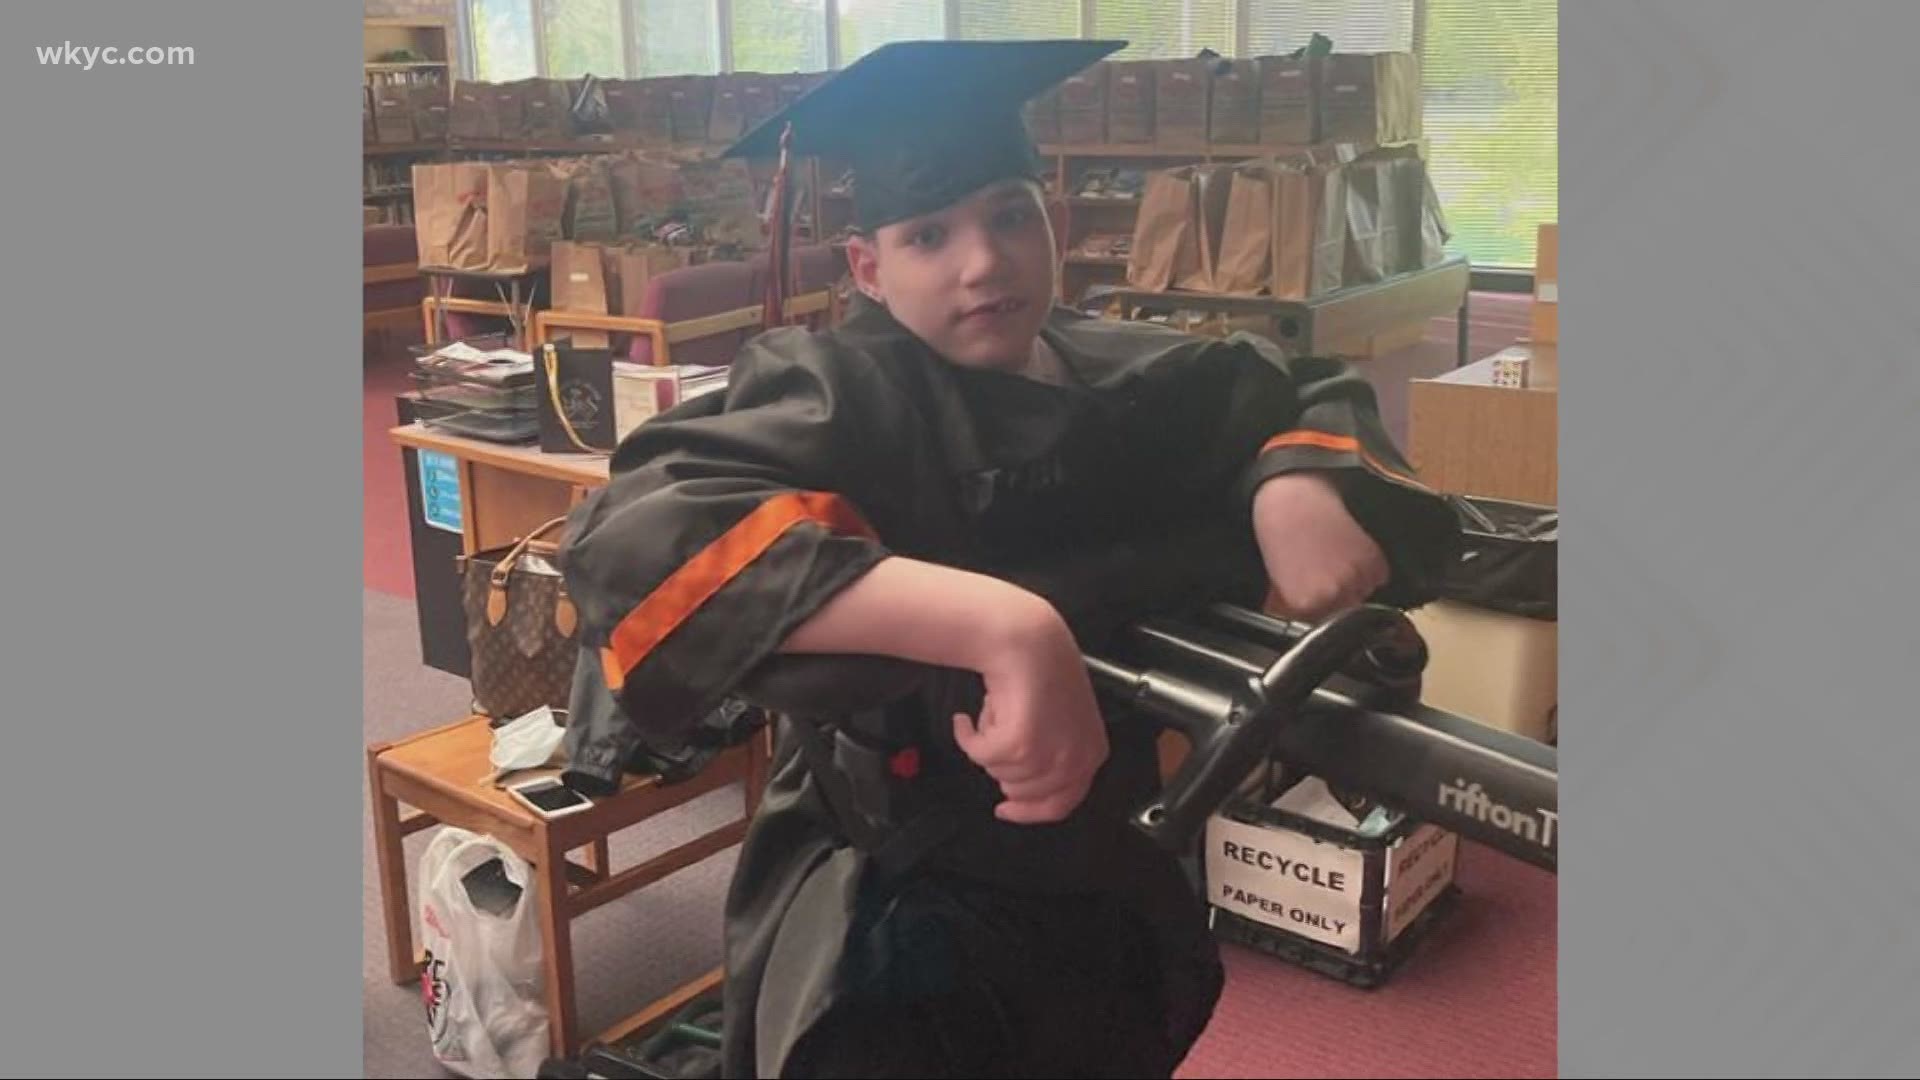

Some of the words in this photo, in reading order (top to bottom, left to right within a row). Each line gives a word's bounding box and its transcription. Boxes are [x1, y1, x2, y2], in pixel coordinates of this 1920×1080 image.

[1223, 841, 1345, 892] RECYCLE
[1223, 885, 1284, 917] PAPER
[1289, 908, 1346, 935] ONLY
